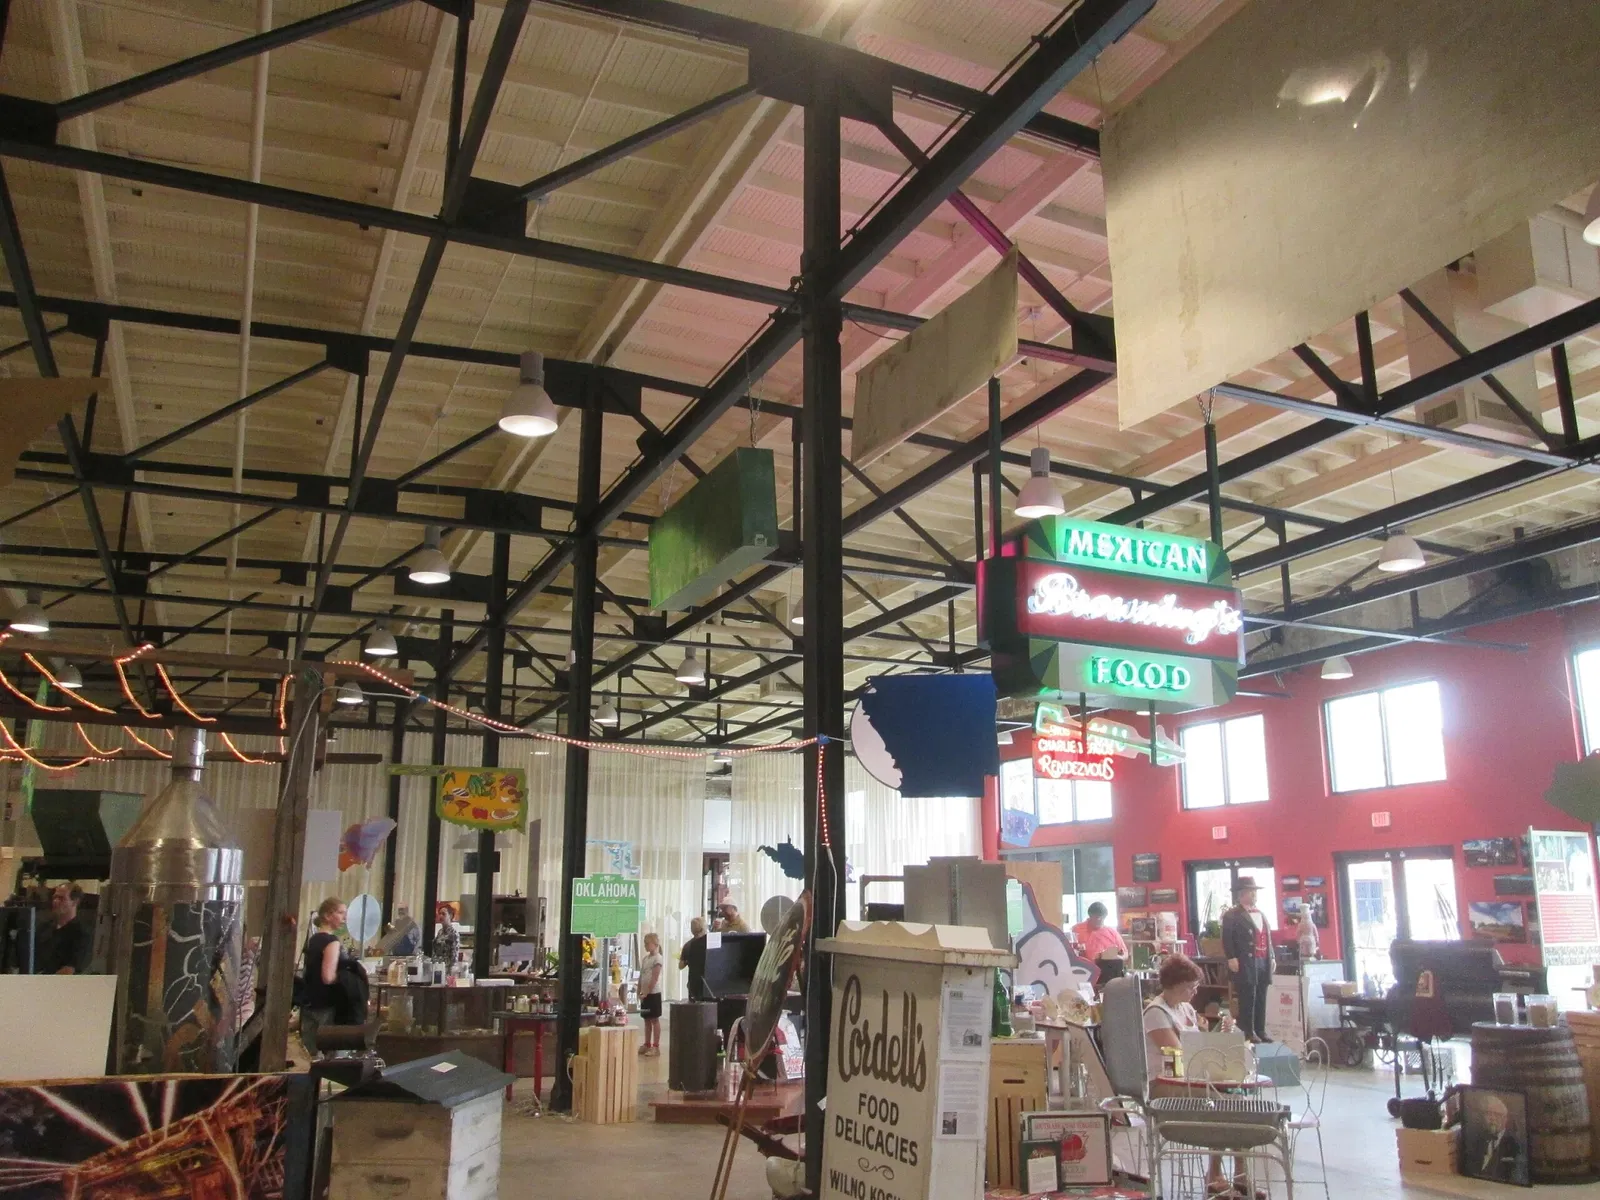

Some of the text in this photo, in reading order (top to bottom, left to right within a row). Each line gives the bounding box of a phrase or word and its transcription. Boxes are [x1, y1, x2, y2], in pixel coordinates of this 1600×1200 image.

[1063, 528, 1207, 574] MEXICAN
[1027, 572, 1244, 645] Browning's
[1090, 655, 1191, 692] FOOD
[1038, 738, 1076, 753] CHARLIE
[1038, 754, 1115, 781] RENDEZVOUS
[575, 882, 637, 898] OKLAHOMA
[837, 974, 927, 1093] Cordell's
[857, 1092, 900, 1127] FOOD
[834, 1114, 919, 1167] DELICACIES
[829, 1168, 866, 1200] WILNO
